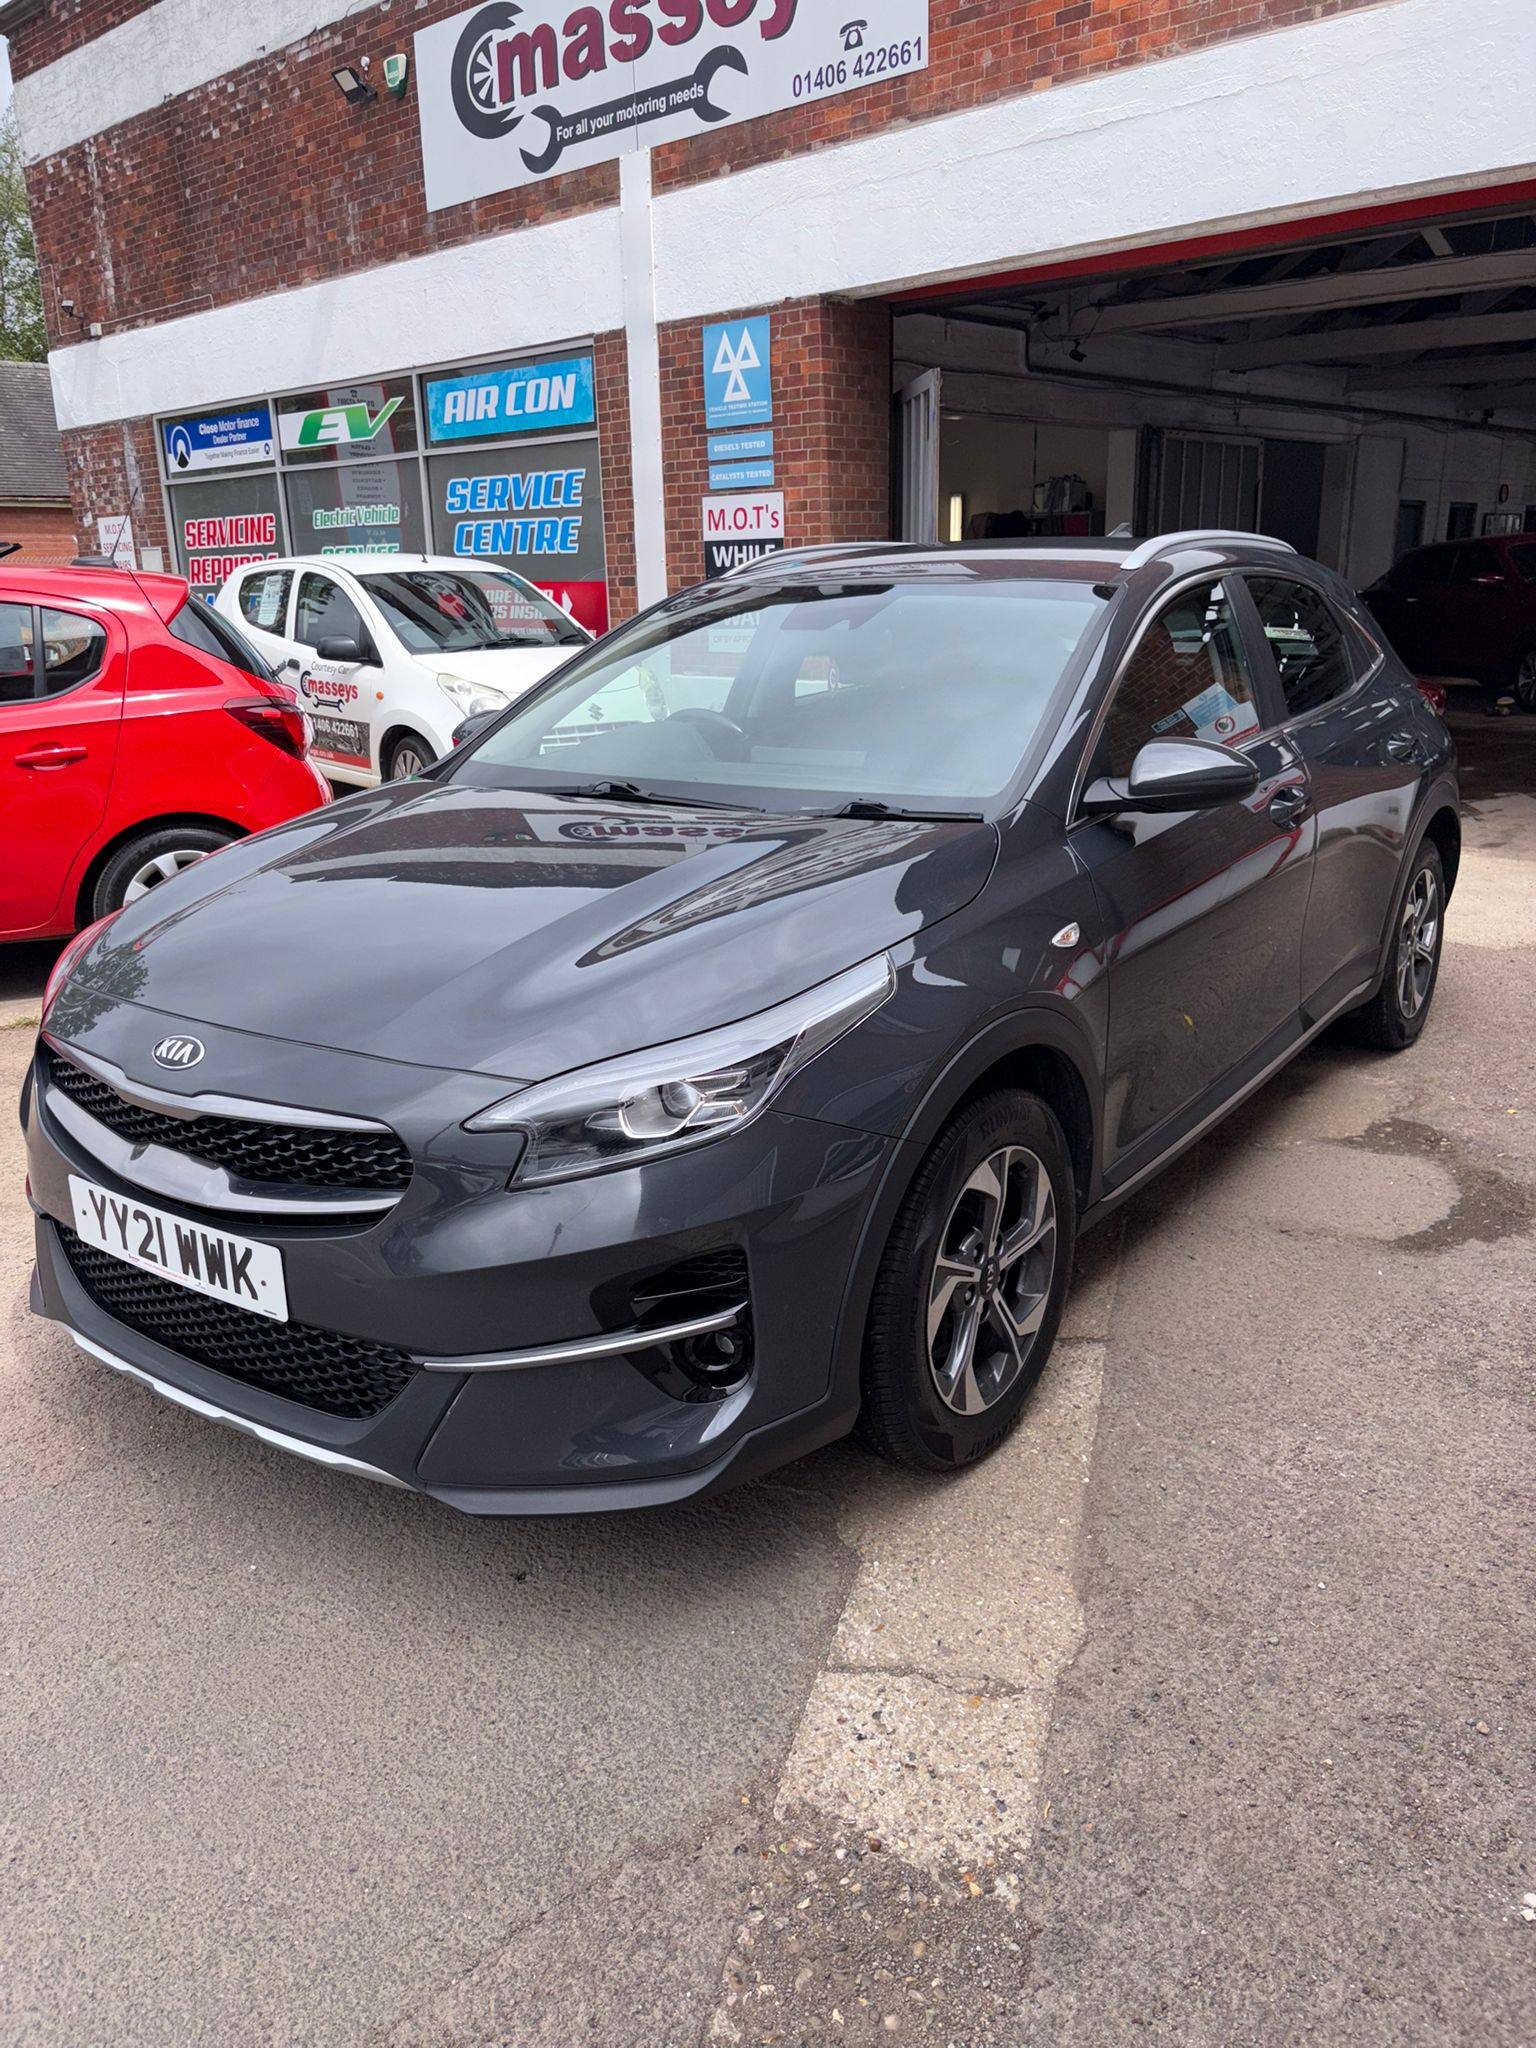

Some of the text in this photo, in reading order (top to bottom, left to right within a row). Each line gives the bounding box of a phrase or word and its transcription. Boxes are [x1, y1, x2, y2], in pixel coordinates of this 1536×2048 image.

[793, 36, 921, 98] 01406 422661
[556, 83, 705, 142] For all your motoring needs
[443, 372, 577, 425] AIR CON
[199, 424, 218, 435] Close
[218, 420, 236, 431] Motor
[298, 396, 406, 445] EV
[229, 432, 247, 442] Partner
[713, 439, 766, 452] DIESELS TESTED
[711, 469, 772, 481] CATALYSTS TESTED
[446, 468, 586, 514] SERVICE
[313, 504, 400, 529] Electric Vehicle
[707, 503, 780, 532] M.O.T's
[185, 513, 276, 549] SERVICING
[454, 516, 583, 556] CENTRE
[311, 661, 336, 676] Courtesy
[308, 679, 358, 703] masseys
[331, 721, 359, 738] 422661
[156, 1038, 194, 1064] KIA
[88, 1189, 259, 1301] YY21 WWK
